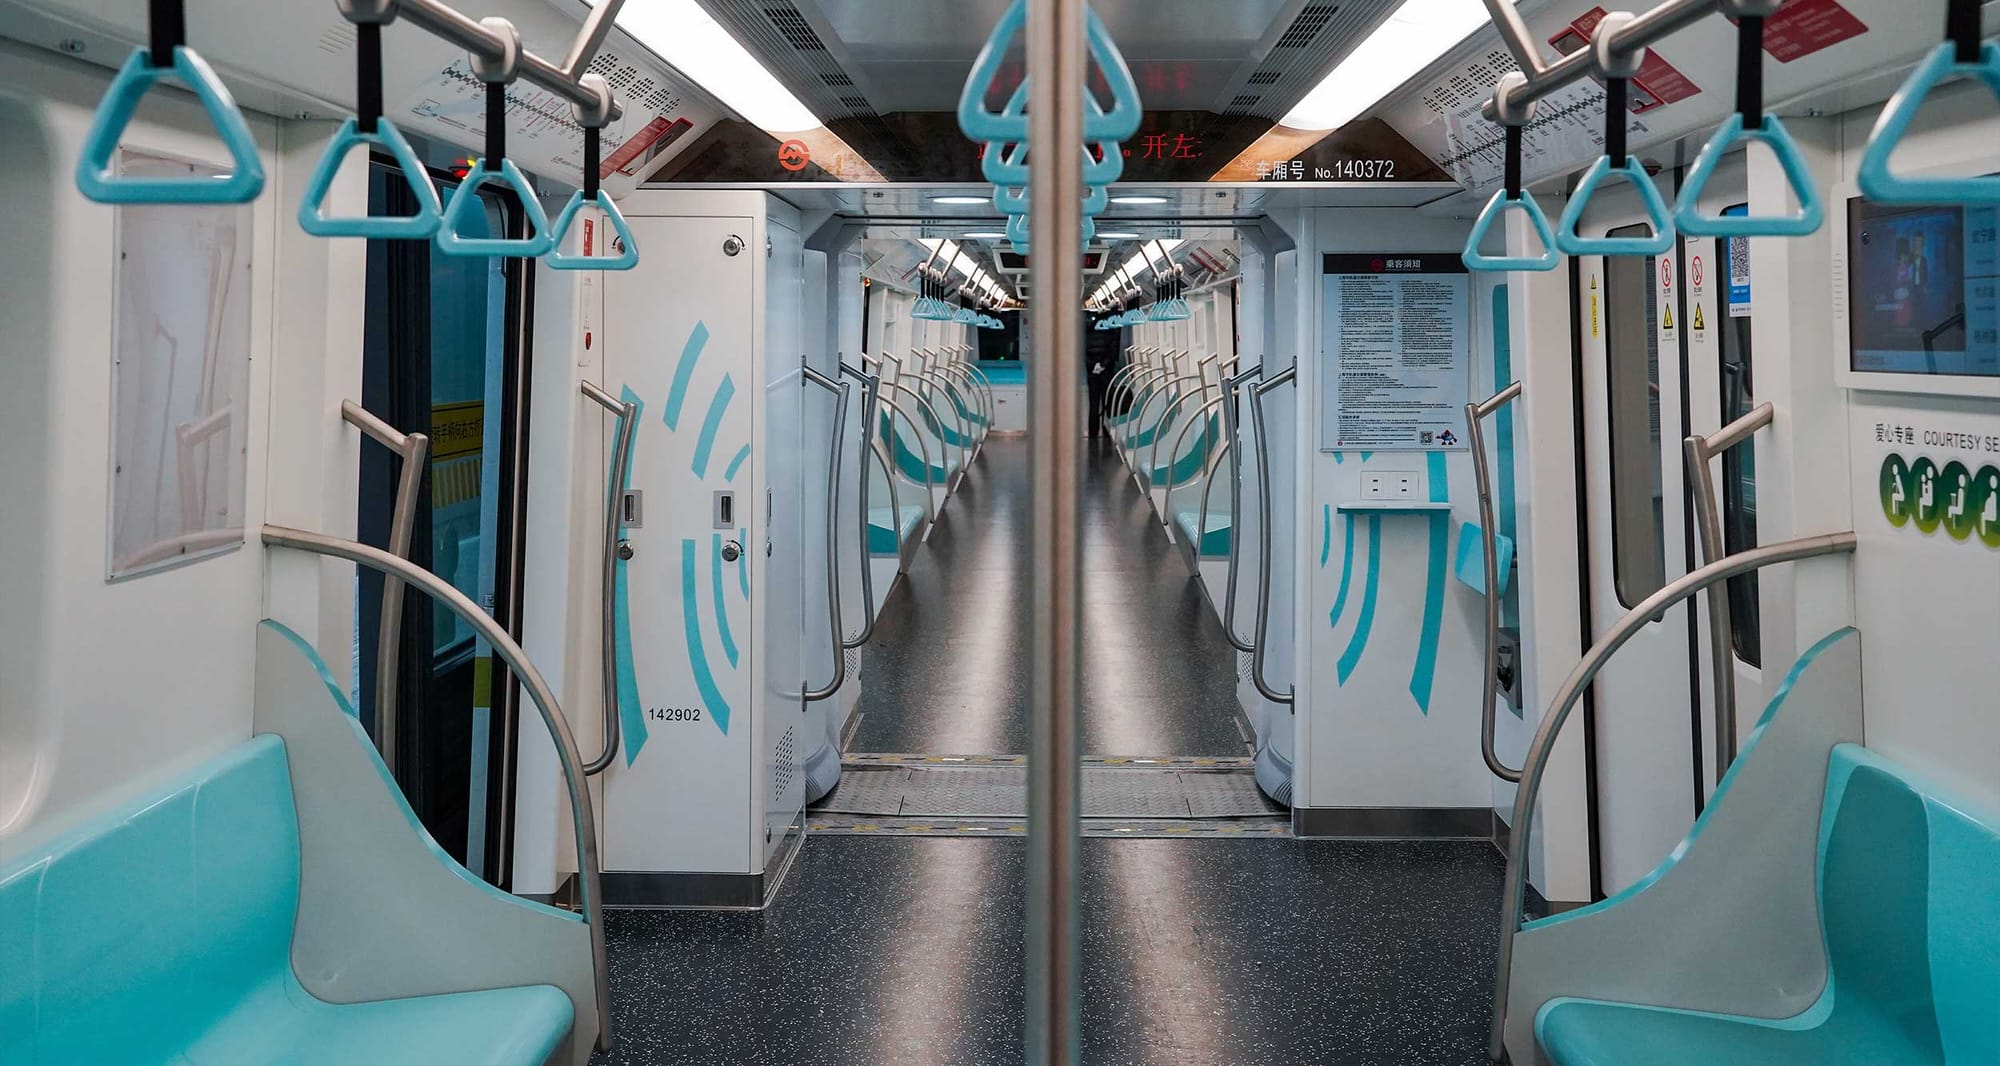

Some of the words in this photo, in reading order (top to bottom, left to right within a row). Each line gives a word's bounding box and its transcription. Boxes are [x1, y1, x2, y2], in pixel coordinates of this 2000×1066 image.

[1256, 160, 1304, 180] 车厢号
[1876, 423, 1914, 446] 爱心专座
[1924, 430, 1981, 450] COURTESY
[649, 708, 701, 722] 142902
